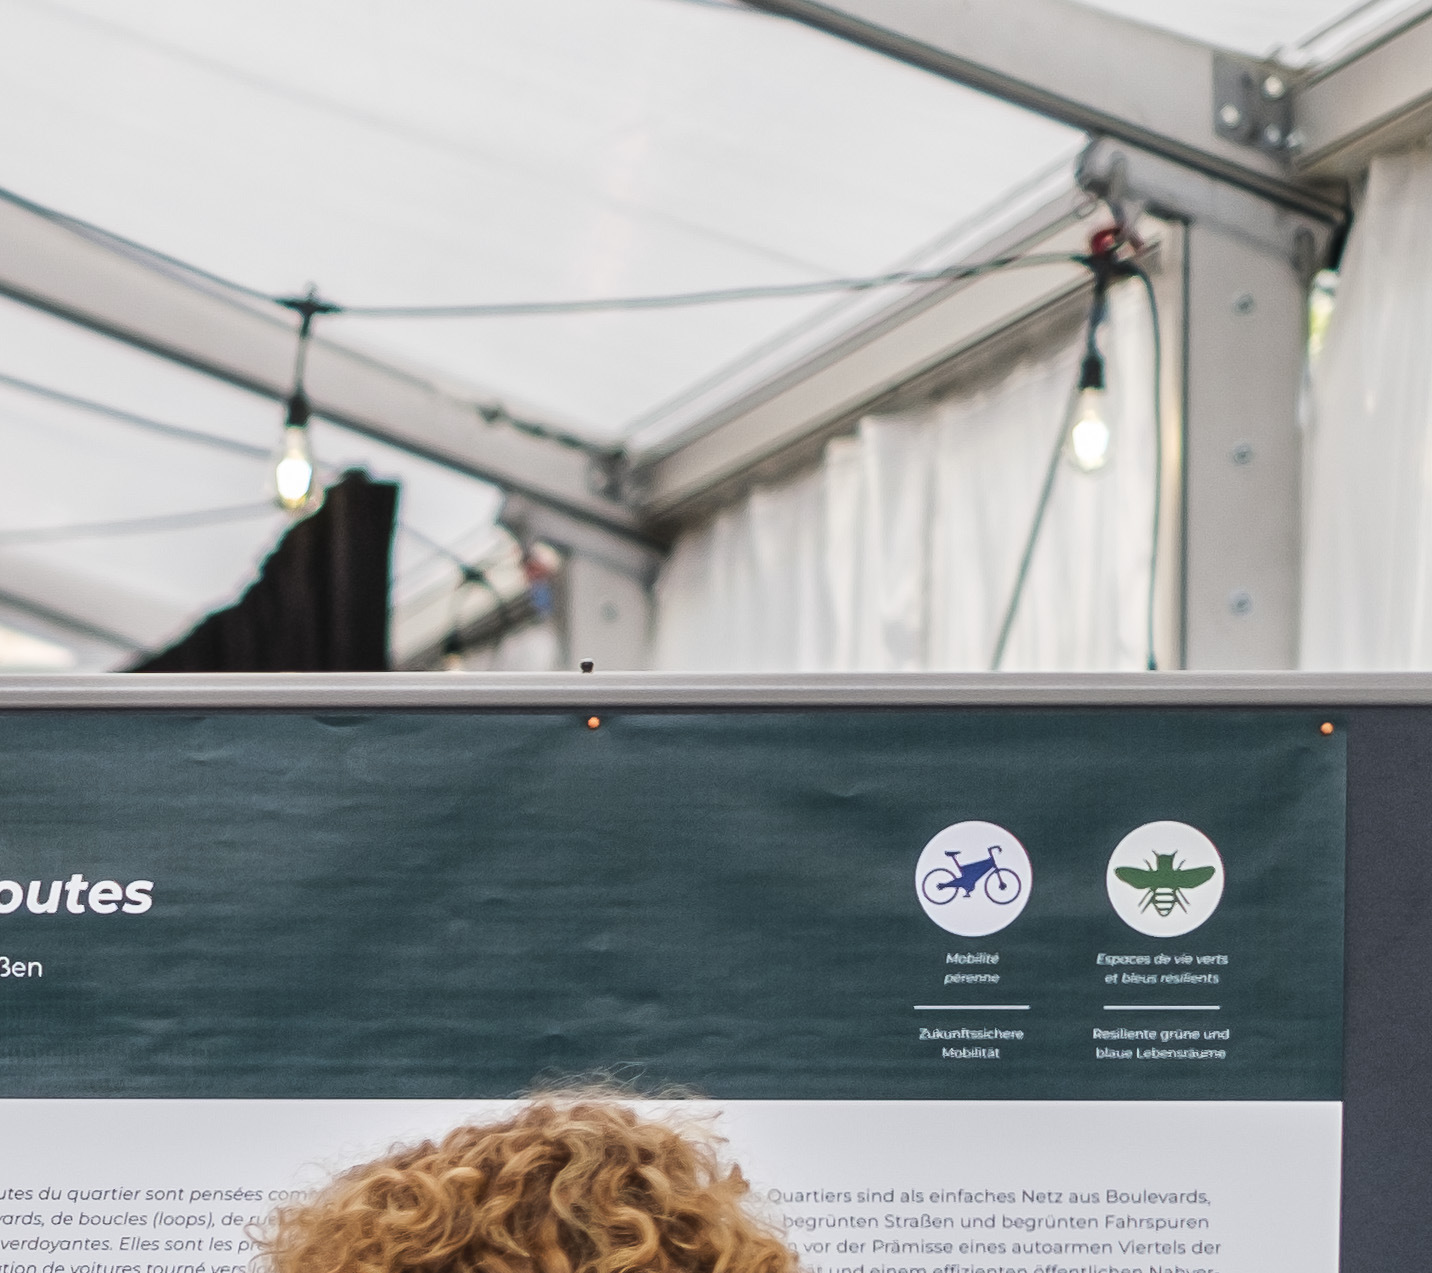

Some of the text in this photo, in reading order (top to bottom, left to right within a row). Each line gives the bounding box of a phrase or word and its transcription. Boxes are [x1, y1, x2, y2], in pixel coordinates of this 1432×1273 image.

[945, 951, 1000, 966] Mobilité
[1096, 952, 1229, 968] Espaces de vie verts
[943, 971, 1001, 985] pérenne
[1104, 971, 1220, 985] et bleus résilients
[918, 1027, 1025, 1041] Zukunftssichere
[1092, 1027, 1230, 1043] Resiliente grüne und
[941, 1045, 1001, 1060] Mobilität
[1095, 1046, 1227, 1060] blaue Lebensräume
[37, 1185, 63, 1201] du
[66, 1185, 142, 1204] quartier
[144, 1187, 185, 1202] sont
[188, 1186, 264, 1205] pensées
[767, 1187, 1212, 1207] Quartiers sind als einfaches Netz aus Boulevards,
[50, 1210, 74, 1226] de
[77, 1211, 148, 1227] boucles
[152, 1210, 216, 1230] (loops),
[220, 1211, 246, 1226] de
[782, 1212, 1210, 1234] begrünten Straßen und begrünten Fahrspuren
[0, 1235, 113, 1255] verdoyantes.
[118, 1235, 161, 1252] Elles
[163, 1237, 205, 1252] sont
[208, 1236, 233, 1252] les
[800, 1238, 1222, 1256] vor der Prämisse eines autoarmen Viertels der
